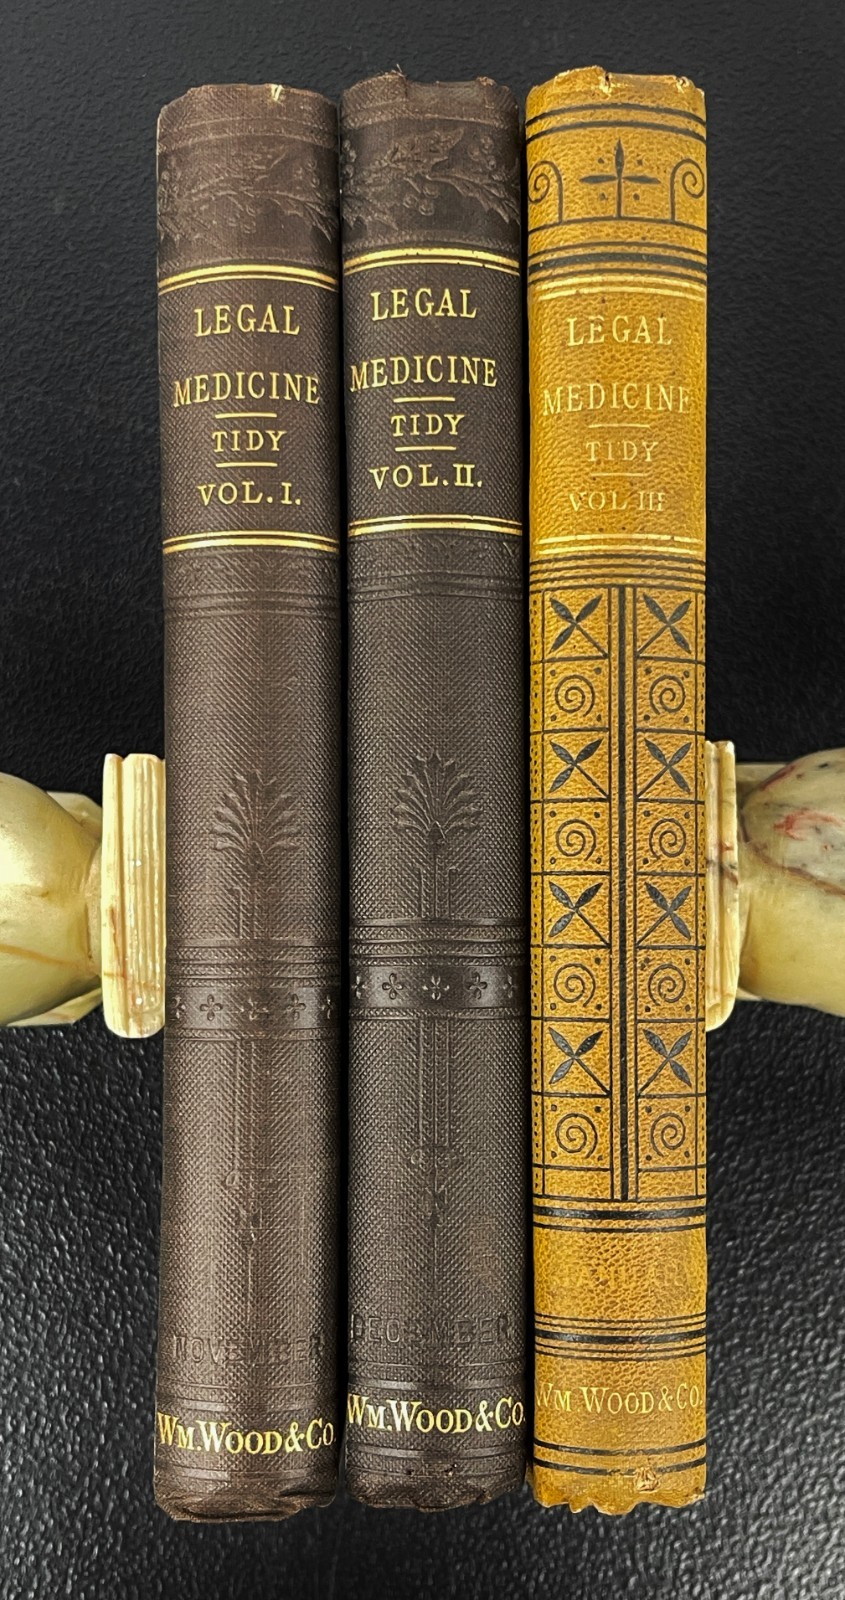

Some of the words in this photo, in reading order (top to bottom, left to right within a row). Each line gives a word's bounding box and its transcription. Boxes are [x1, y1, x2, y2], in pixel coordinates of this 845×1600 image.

[194, 304, 300, 337] LEGAL
[370, 288, 477, 321] LEGAL
[566, 315, 672, 346] LEGAL
[173, 372, 320, 408] MEDICINE
[350, 355, 497, 393] MEDICINE
[212, 430, 287, 452] TIDY
[391, 414, 465, 437] TIDY
[585, 441, 659, 462] TIDY
